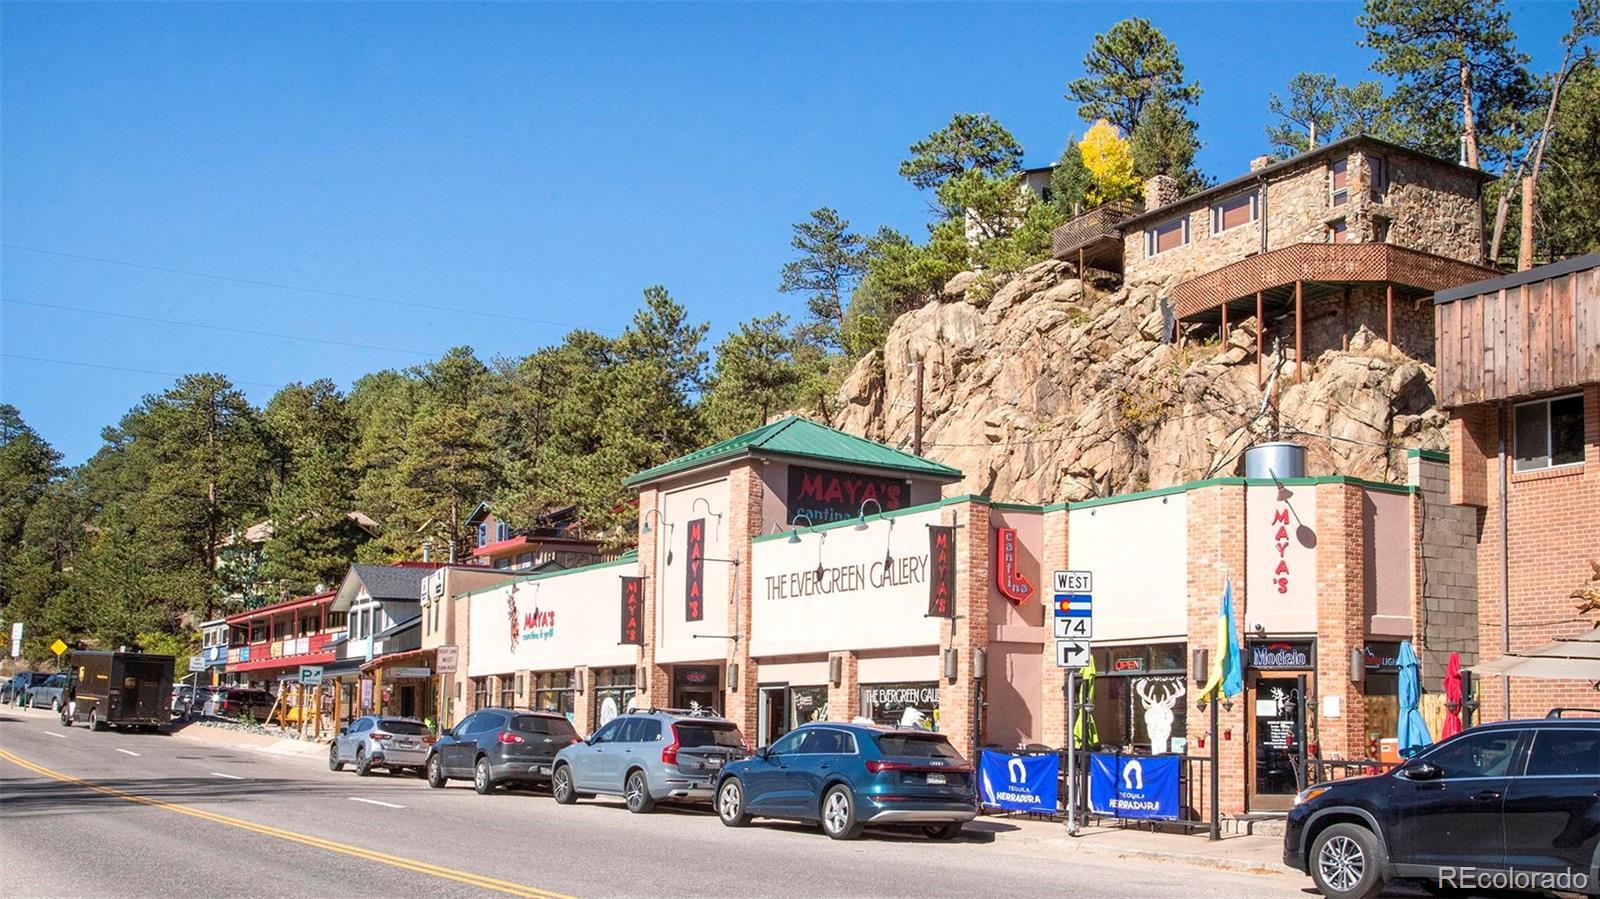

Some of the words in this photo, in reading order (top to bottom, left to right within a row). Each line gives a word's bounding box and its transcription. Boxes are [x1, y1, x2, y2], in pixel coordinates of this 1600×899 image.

[797, 473, 900, 508] MAYA'S
[797, 508, 851, 522] cantina
[1272, 508, 1290, 594] MAYA'S
[1005, 532, 1029, 593] cantina
[690, 524, 701, 618] MAYA'S
[765, 574, 788, 600] THE
[790, 564, 865, 598] EVERGREEN
[870, 554, 928, 588] GALLERY
[936, 533, 947, 613] MAYA'S
[1058, 575, 1088, 588] WEST
[626, 582, 637, 641] MAYA'S
[523, 610, 555, 630] MAYA'S
[1060, 619, 1086, 635] 74
[1253, 647, 1306, 666] Modelo
[1381, 657, 1398, 666] LIGH
[1115, 660, 1140, 670] OPEN
[302, 669, 312, 681] P
[865, 689, 879, 702] THE
[880, 688, 919, 702] EVERGREEN
[920, 688, 940, 702] GALLE
[1008, 785, 1030, 793] TEQUILA
[996, 791, 1041, 804] HERRADURA
[1109, 799, 1159, 811] HERRADURA
